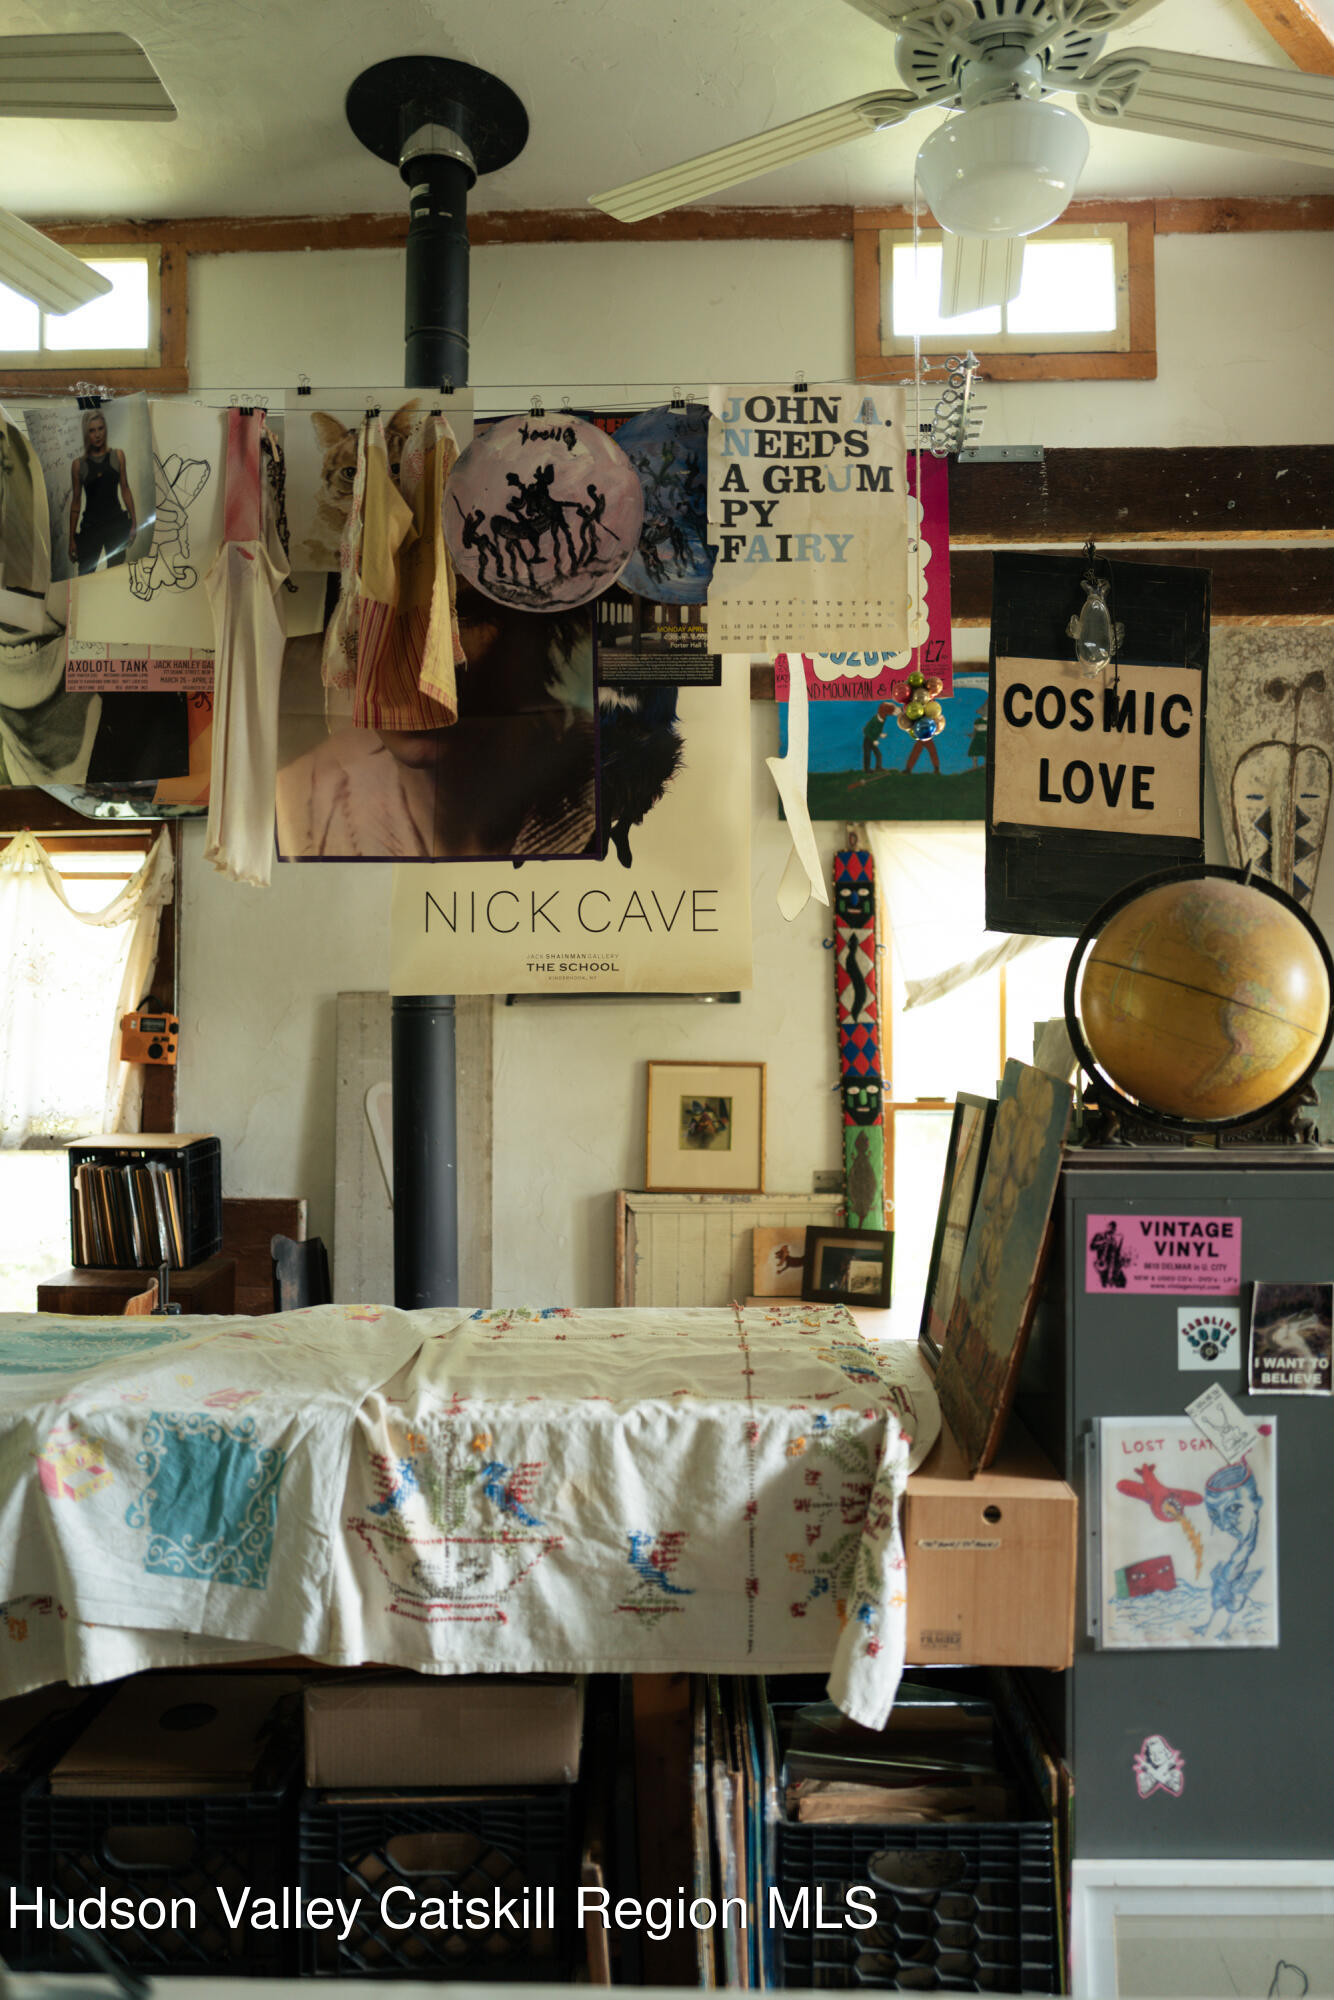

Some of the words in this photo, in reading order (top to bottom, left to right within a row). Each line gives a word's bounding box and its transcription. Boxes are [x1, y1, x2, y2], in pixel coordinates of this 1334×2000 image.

[721, 396, 842, 424] JOHN
[720, 428, 870, 459] NEEDS
[719, 464, 749, 493] A
[762, 464, 895, 494] GRUM
[720, 499, 780, 528] PY
[720, 534, 855, 563] FAIRY
[68, 660, 116, 673] AXOLOTL
[120, 660, 148, 673] TANK
[154, 661, 171, 669] JACK
[173, 661, 200, 669] HANLEY
[822, 681, 873, 698] MOUNTAIN
[1003, 683, 1193, 738] COSMIC
[1039, 758, 1155, 810] LOVE
[426, 890, 561, 933] NICK
[578, 890, 719, 933] CAVE
[526, 962, 556, 972] THE
[559, 962, 620, 972] SCHOOL
[1140, 1221, 1233, 1239] VINTAGE
[1154, 1241, 1219, 1258] VINYL
[1187, 1327, 1231, 1349] SOUL
[1254, 1357, 1260, 1368] I
[1262, 1357, 1305, 1369] WANT
[1309, 1358, 1329, 1369] TO
[1261, 1372, 1323, 1385] BELIEVE
[1121, 1439, 1166, 1454] LOST
